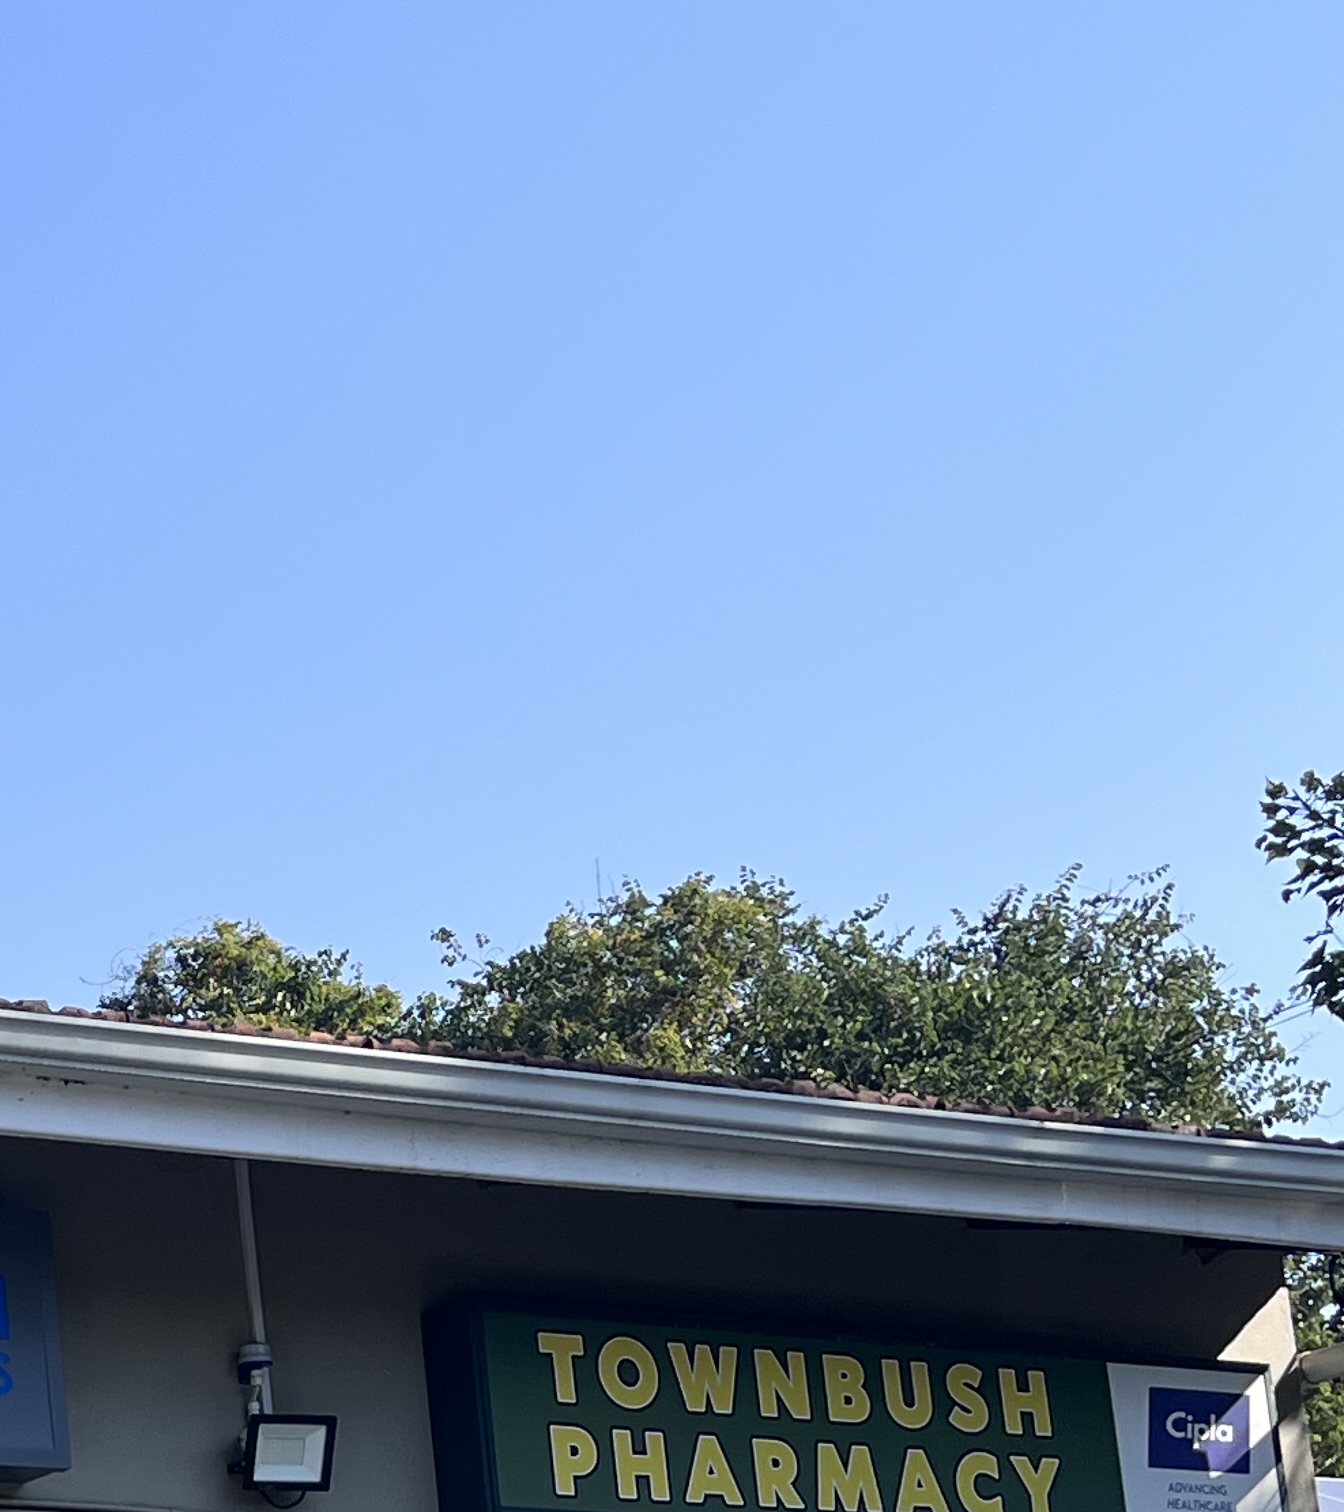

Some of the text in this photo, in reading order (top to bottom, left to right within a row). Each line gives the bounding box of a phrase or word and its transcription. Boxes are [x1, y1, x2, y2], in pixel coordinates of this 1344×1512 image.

[537, 1331, 1053, 1437] TOWNBUSH
[1165, 1411, 1234, 1450] Cipla
[1168, 1482, 1228, 1496] ADVANCING
[1167, 1498, 1233, 1512] HEALTHCARE
